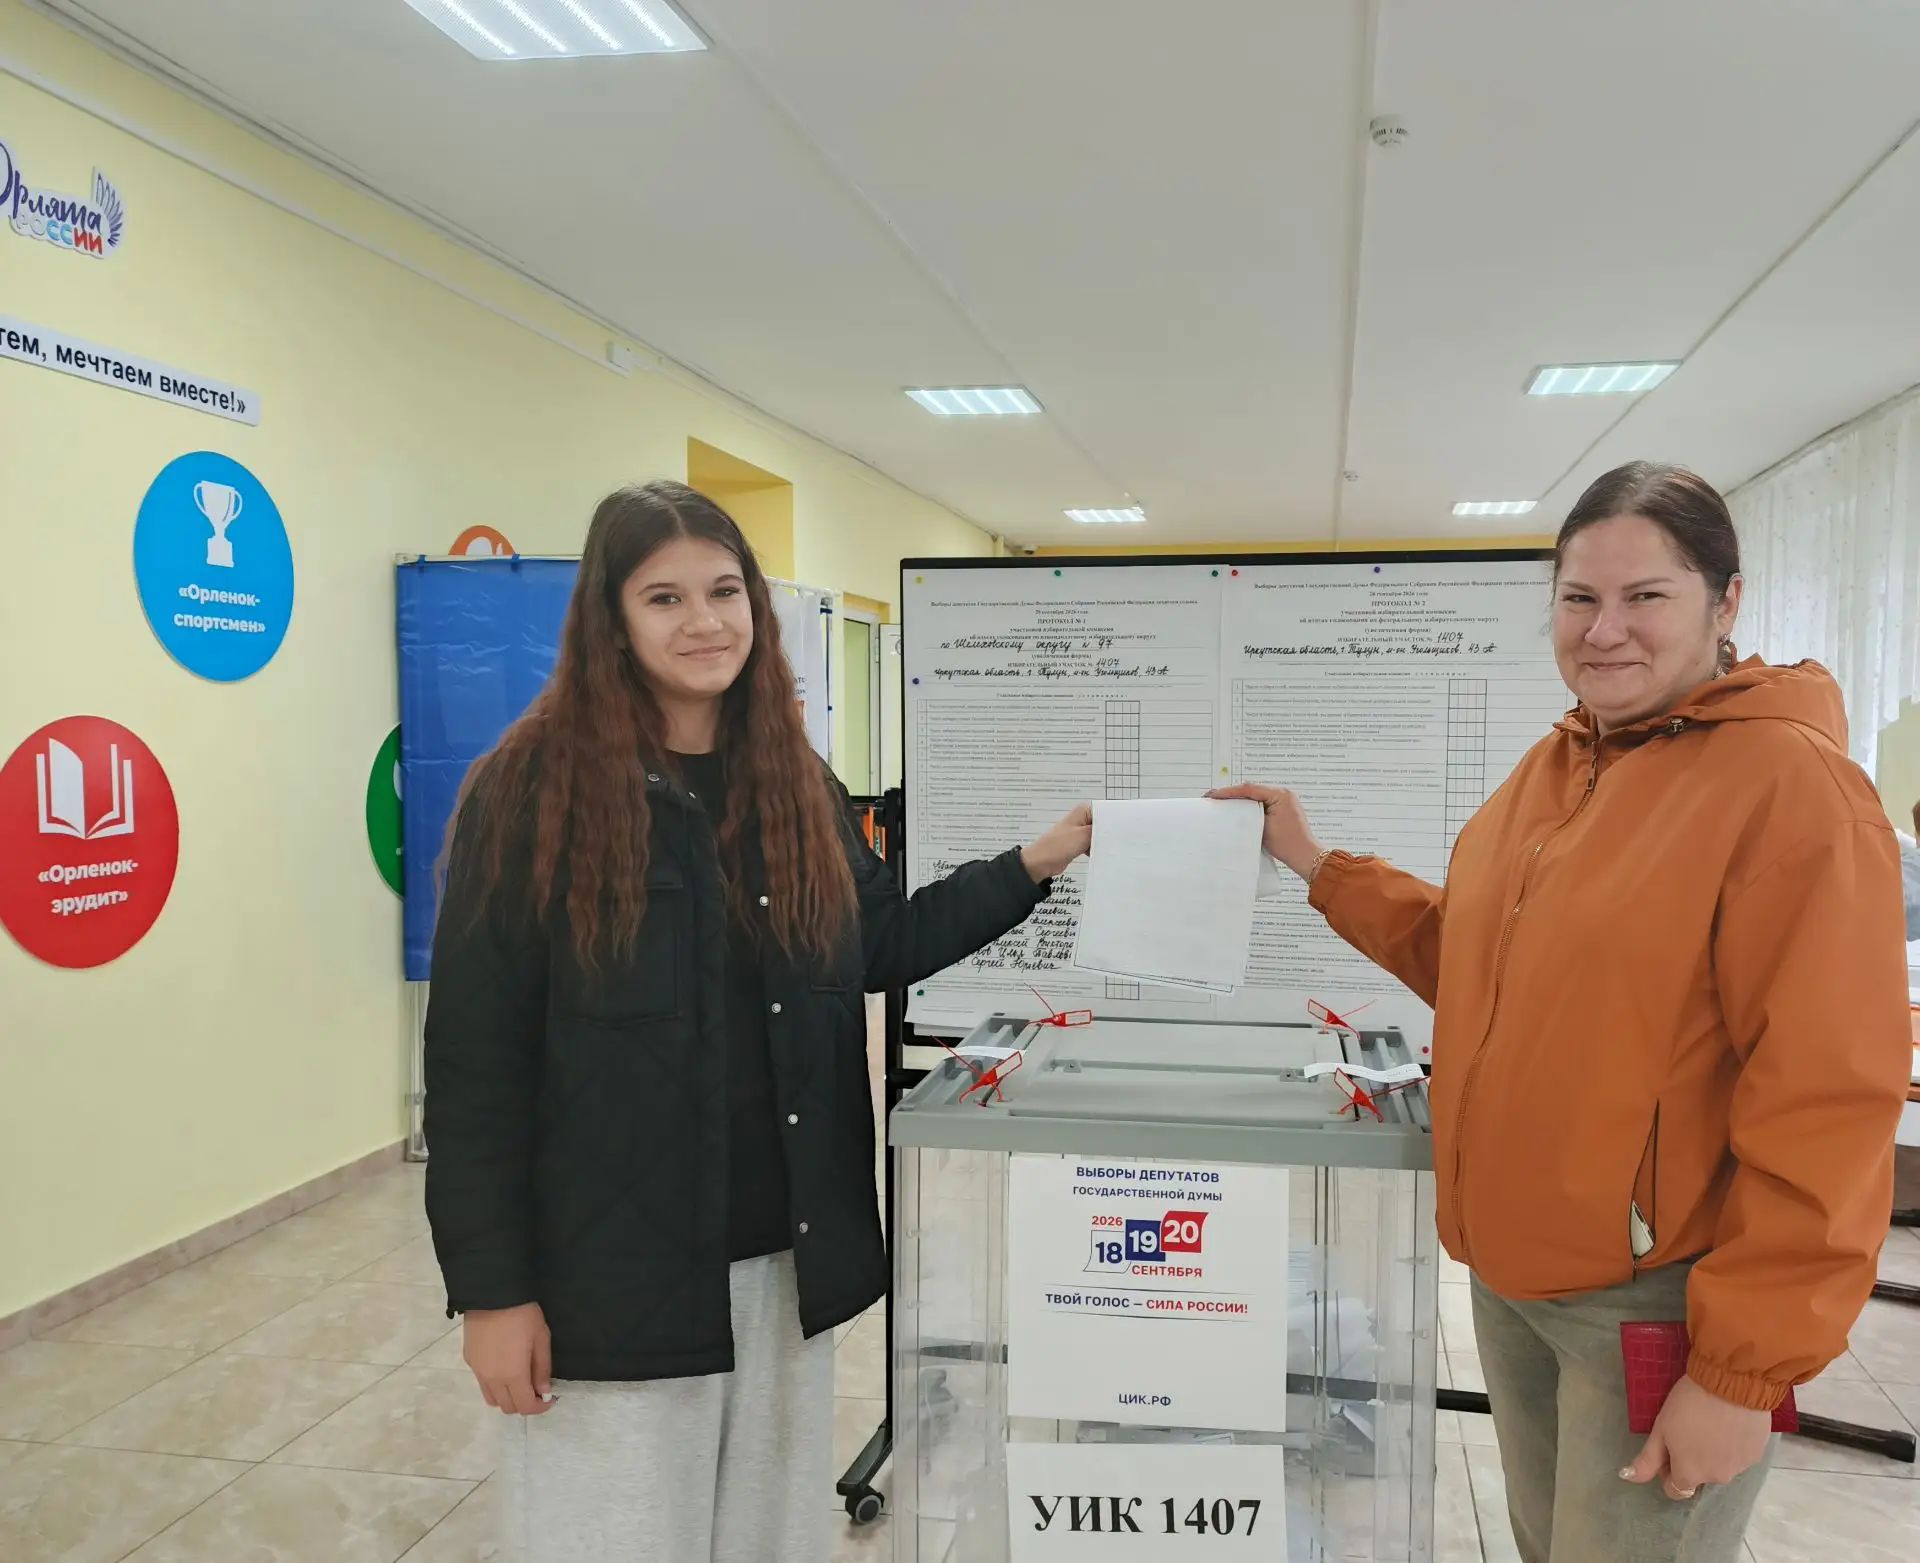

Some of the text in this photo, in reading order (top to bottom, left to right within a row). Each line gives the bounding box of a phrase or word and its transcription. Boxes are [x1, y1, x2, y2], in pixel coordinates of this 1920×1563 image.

[56, 344, 152, 388] мечтаем
[160, 375, 246, 414] вместе!»
[178, 584, 261, 607] «Орленок-
[173, 613, 266, 633] спортсмен»
[1035, 641, 1072, 654] округу
[1098, 638, 1114, 650] 97
[1437, 631, 1464, 644] 1407
[1468, 642, 1480, 654] 43
[1096, 658, 1120, 668] 1407
[38, 859, 139, 885] «Орленок-
[51, 889, 128, 916] эрудит»
[1036, 937, 1074, 950] Викторо
[971, 957, 1004, 974] Сергей
[1076, 1167, 1220, 1183] ВЫБОРЫ ДЕПУТАТОВ
[1072, 1185, 1223, 1202] ГОСУДАРСТВЕННОЙ ДУМЫ
[1091, 1216, 1123, 1228] 2026
[1095, 1219, 1200, 1265] 18 19 20
[1131, 1264, 1203, 1278] СЕНТЯБРЯ
[1045, 1292, 1082, 1306] ТВОЙ
[1085, 1295, 1131, 1309] ГОЛОС
[1146, 1299, 1184, 1311] СИЛА
[1187, 1300, 1249, 1314] РОССИИ!
[1118, 1393, 1172, 1407] ЦИК.РФ
[1027, 1495, 1262, 1537] УИК 1407
